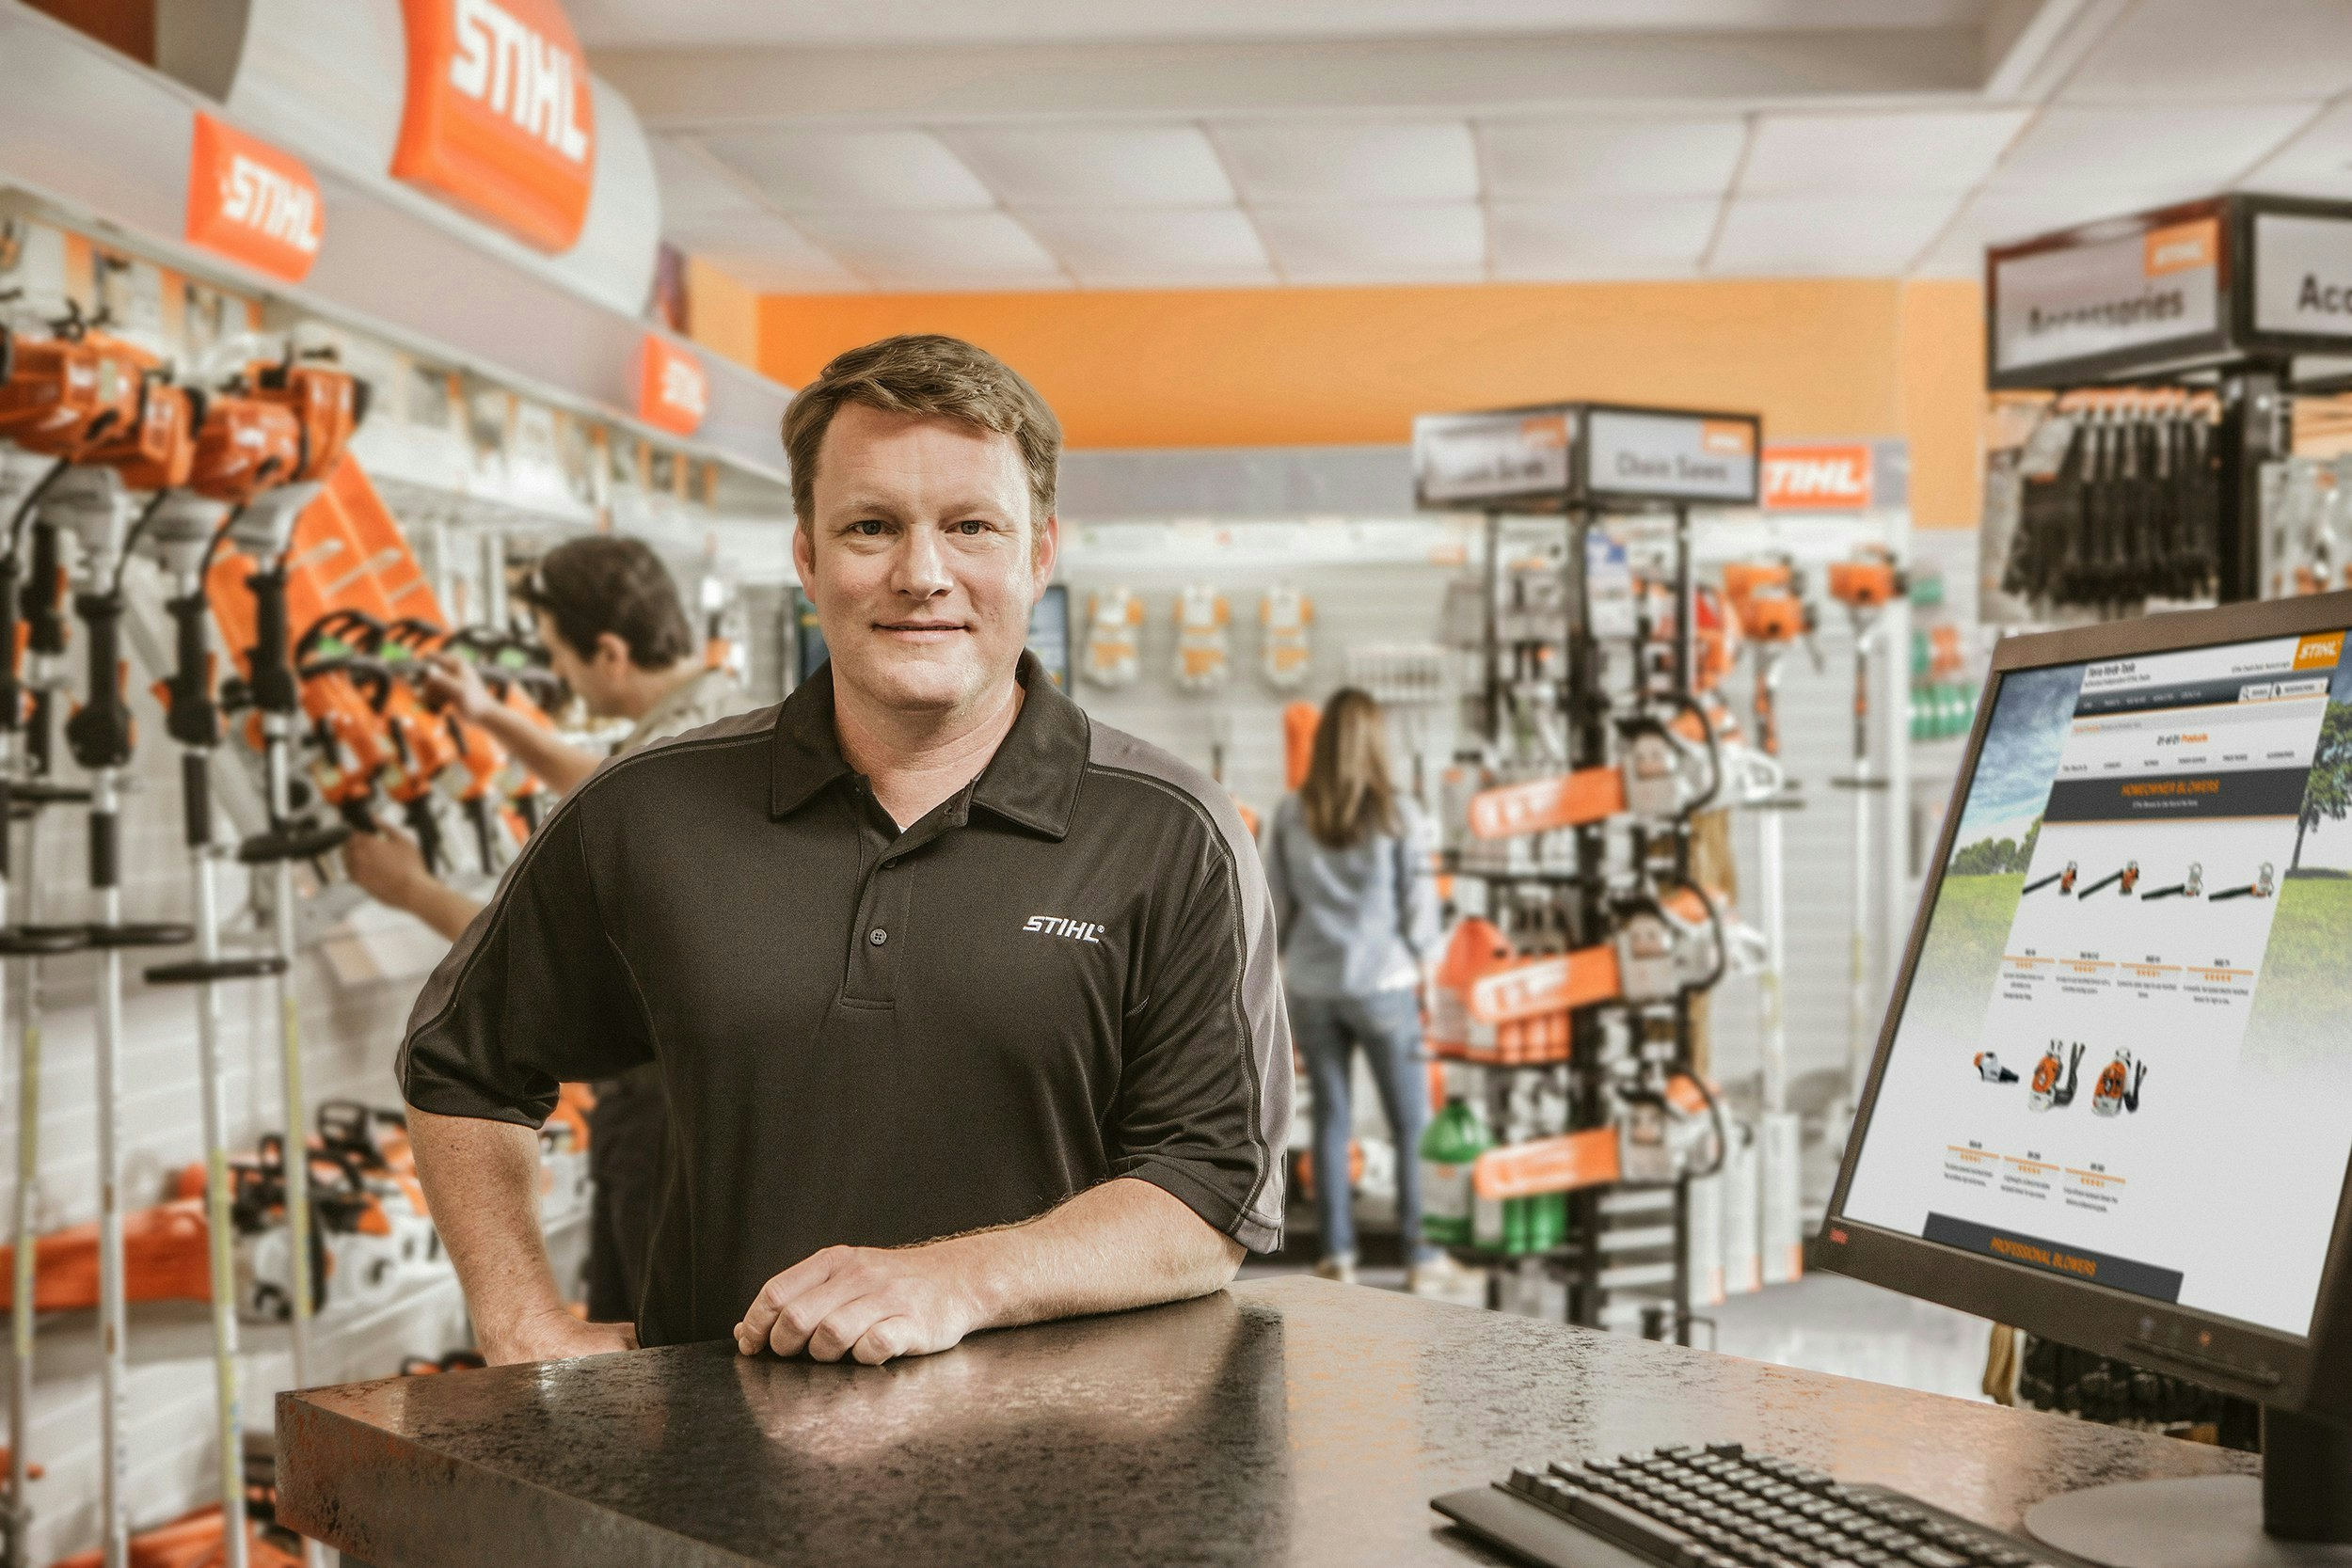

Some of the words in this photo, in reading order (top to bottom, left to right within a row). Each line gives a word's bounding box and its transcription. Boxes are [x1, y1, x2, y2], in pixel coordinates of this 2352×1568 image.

[450, 0, 587, 163] STIHL
[223, 155, 320, 251] STIHL
[1765, 458, 1861, 495] TIHL
[2299, 641, 2337, 660] STIHL
